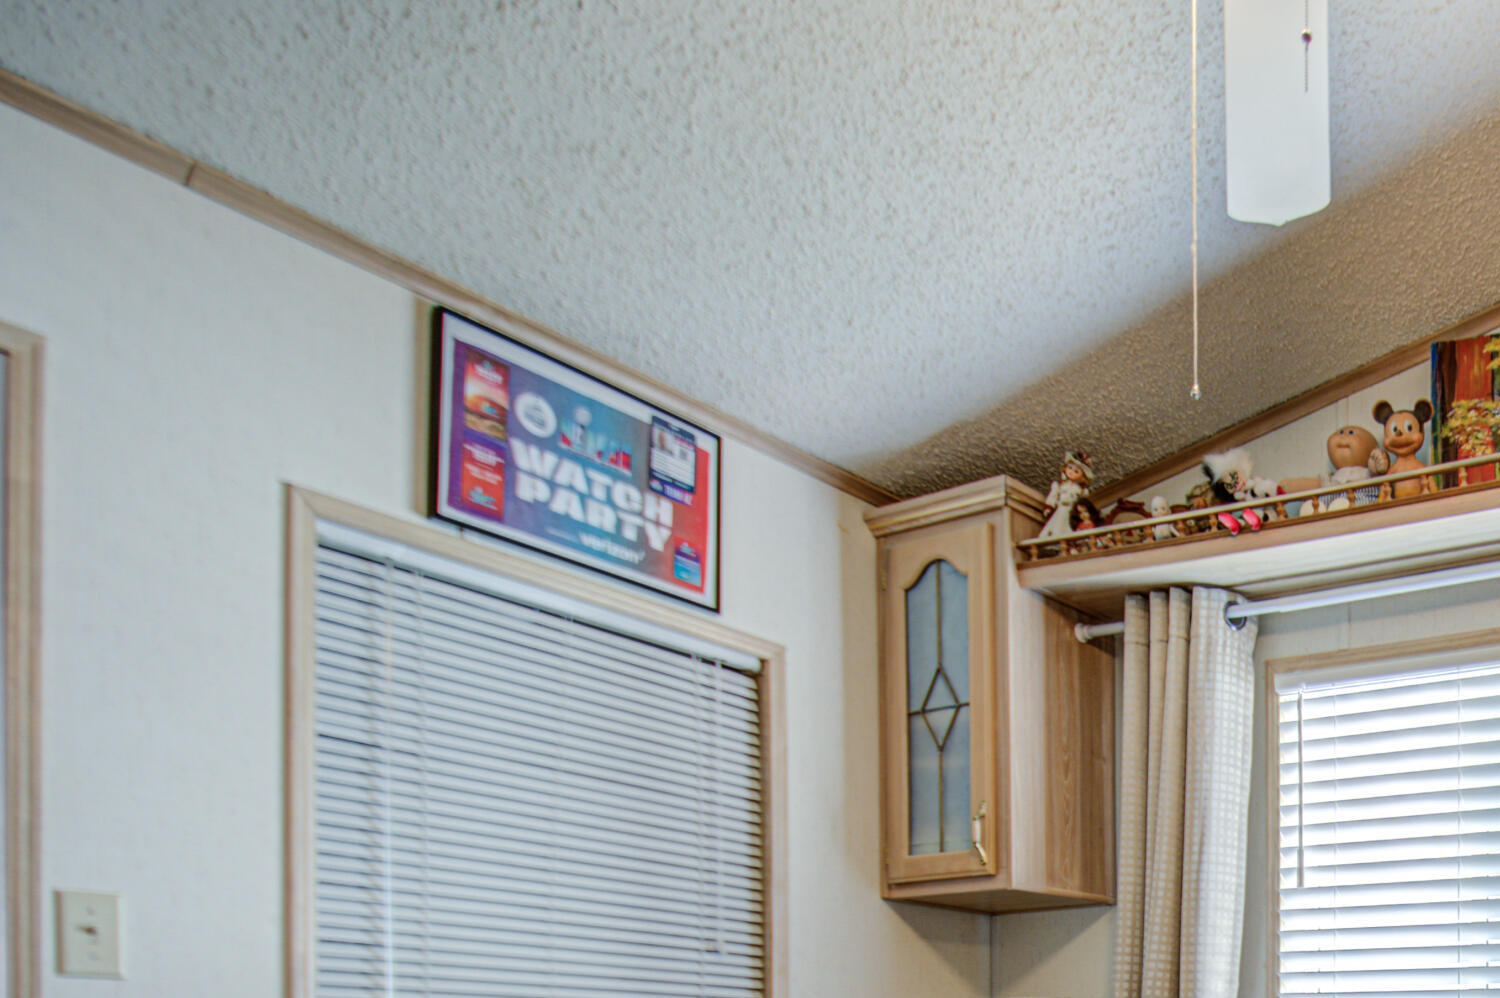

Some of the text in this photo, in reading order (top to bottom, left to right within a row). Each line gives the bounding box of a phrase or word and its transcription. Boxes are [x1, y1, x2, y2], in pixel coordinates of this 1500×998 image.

[509, 438, 673, 527] WATCH
[513, 468, 672, 552] PARTY
[579, 532, 640, 564] verizon
